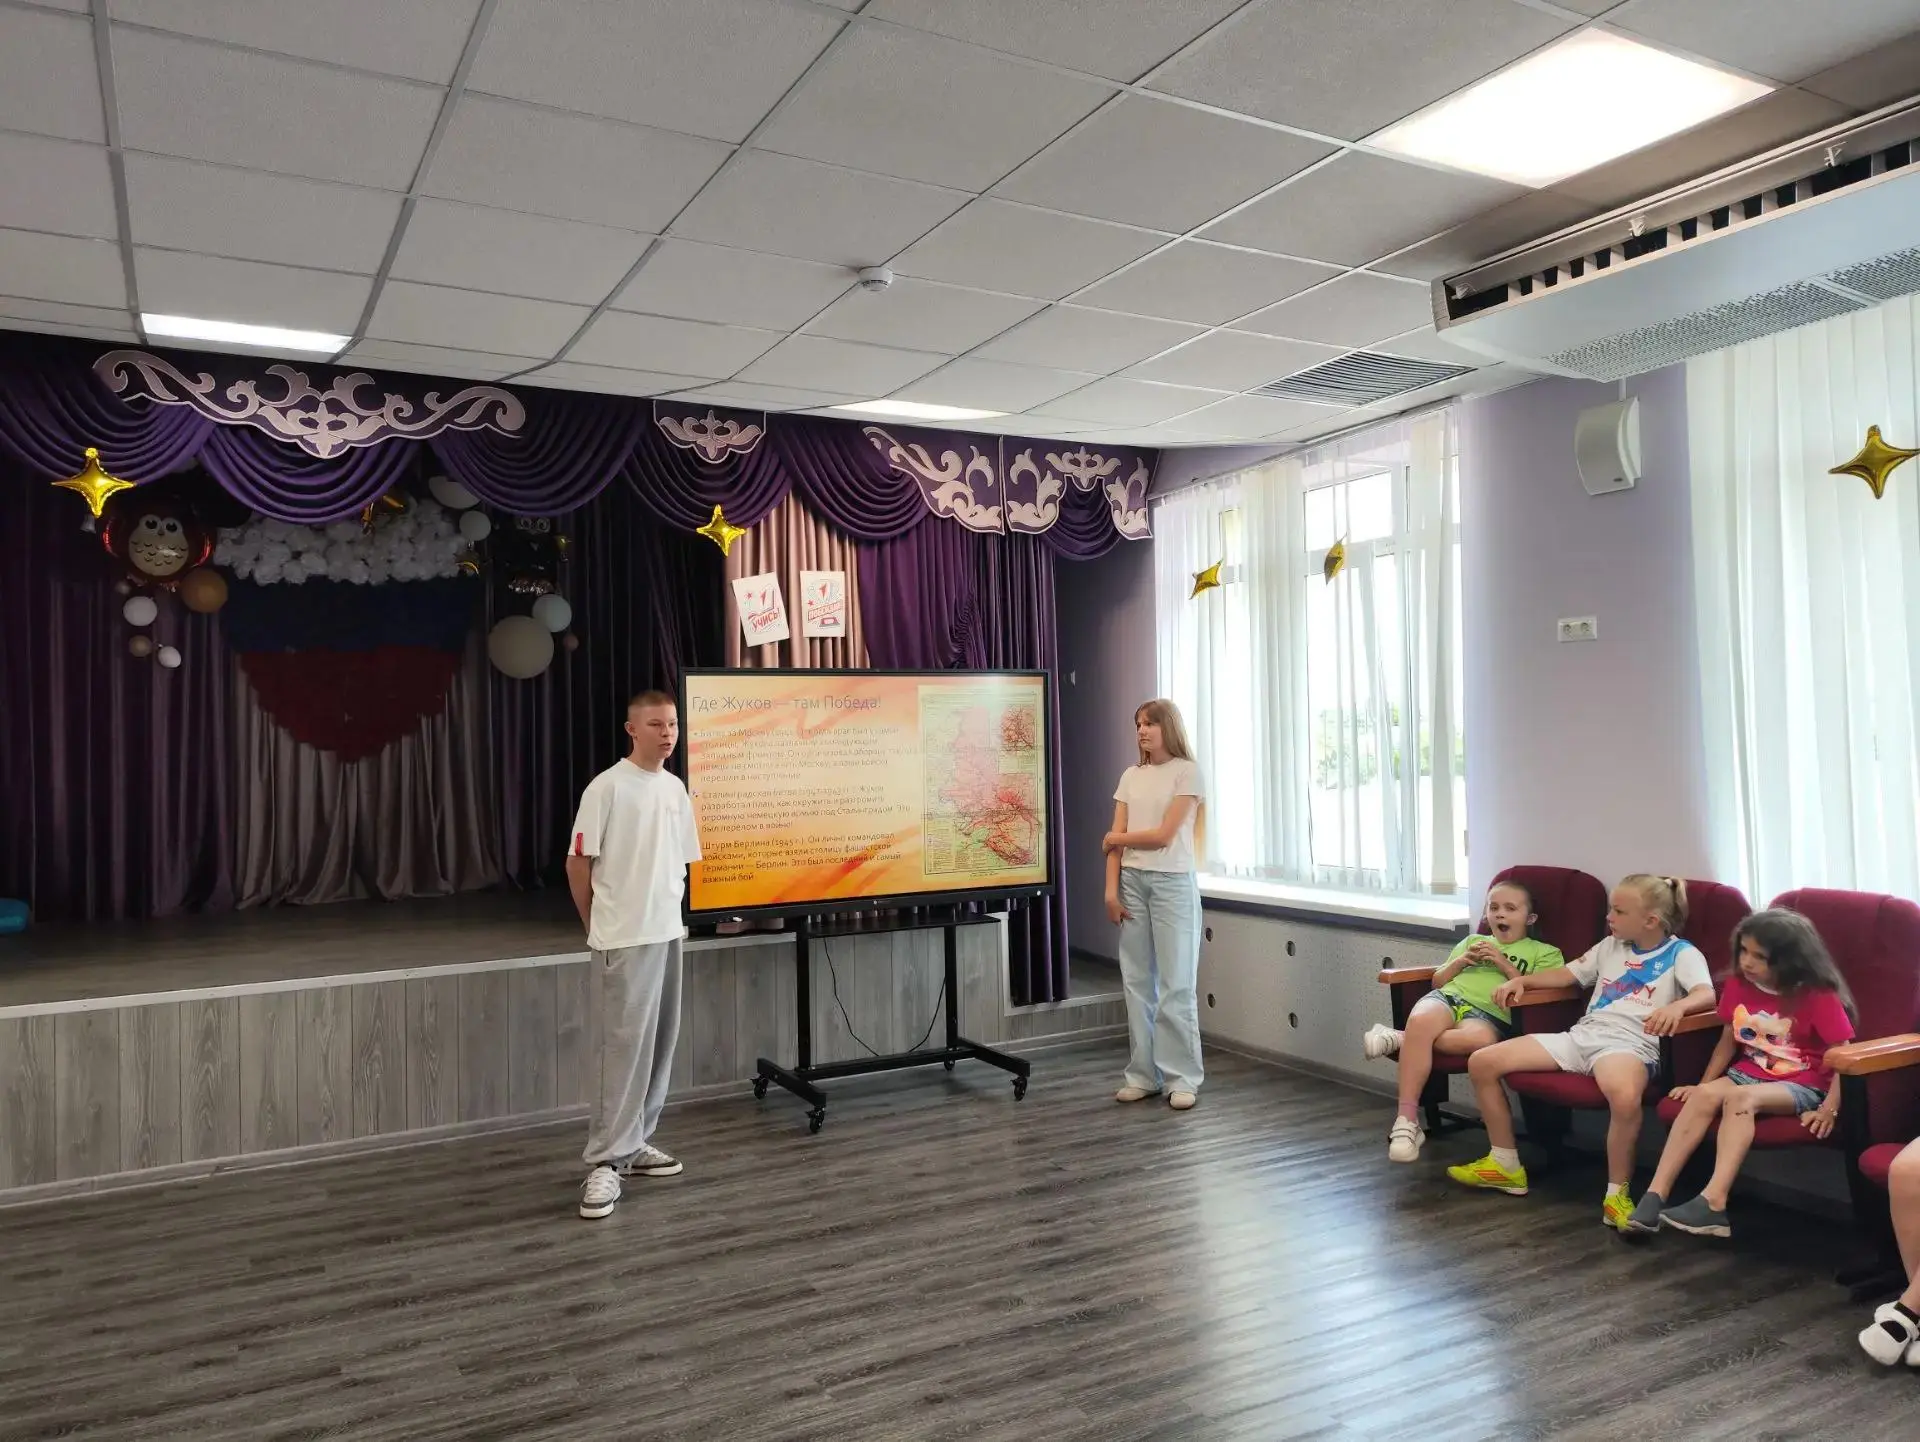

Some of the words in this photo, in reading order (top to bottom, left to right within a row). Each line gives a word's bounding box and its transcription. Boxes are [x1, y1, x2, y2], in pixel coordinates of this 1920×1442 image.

[692, 696, 718, 713] Где
[722, 696, 773, 713] Жуков
[793, 698, 820, 709] там
[824, 695, 881, 711] Победа!
[701, 812, 745, 823] огромную
[702, 840, 732, 852] Штурм
[734, 838, 770, 850] Берлина
[848, 832, 895, 842] командовал
[748, 848, 782, 859] которые
[702, 862, 744, 873] Германии
[702, 873, 736, 884] важный
